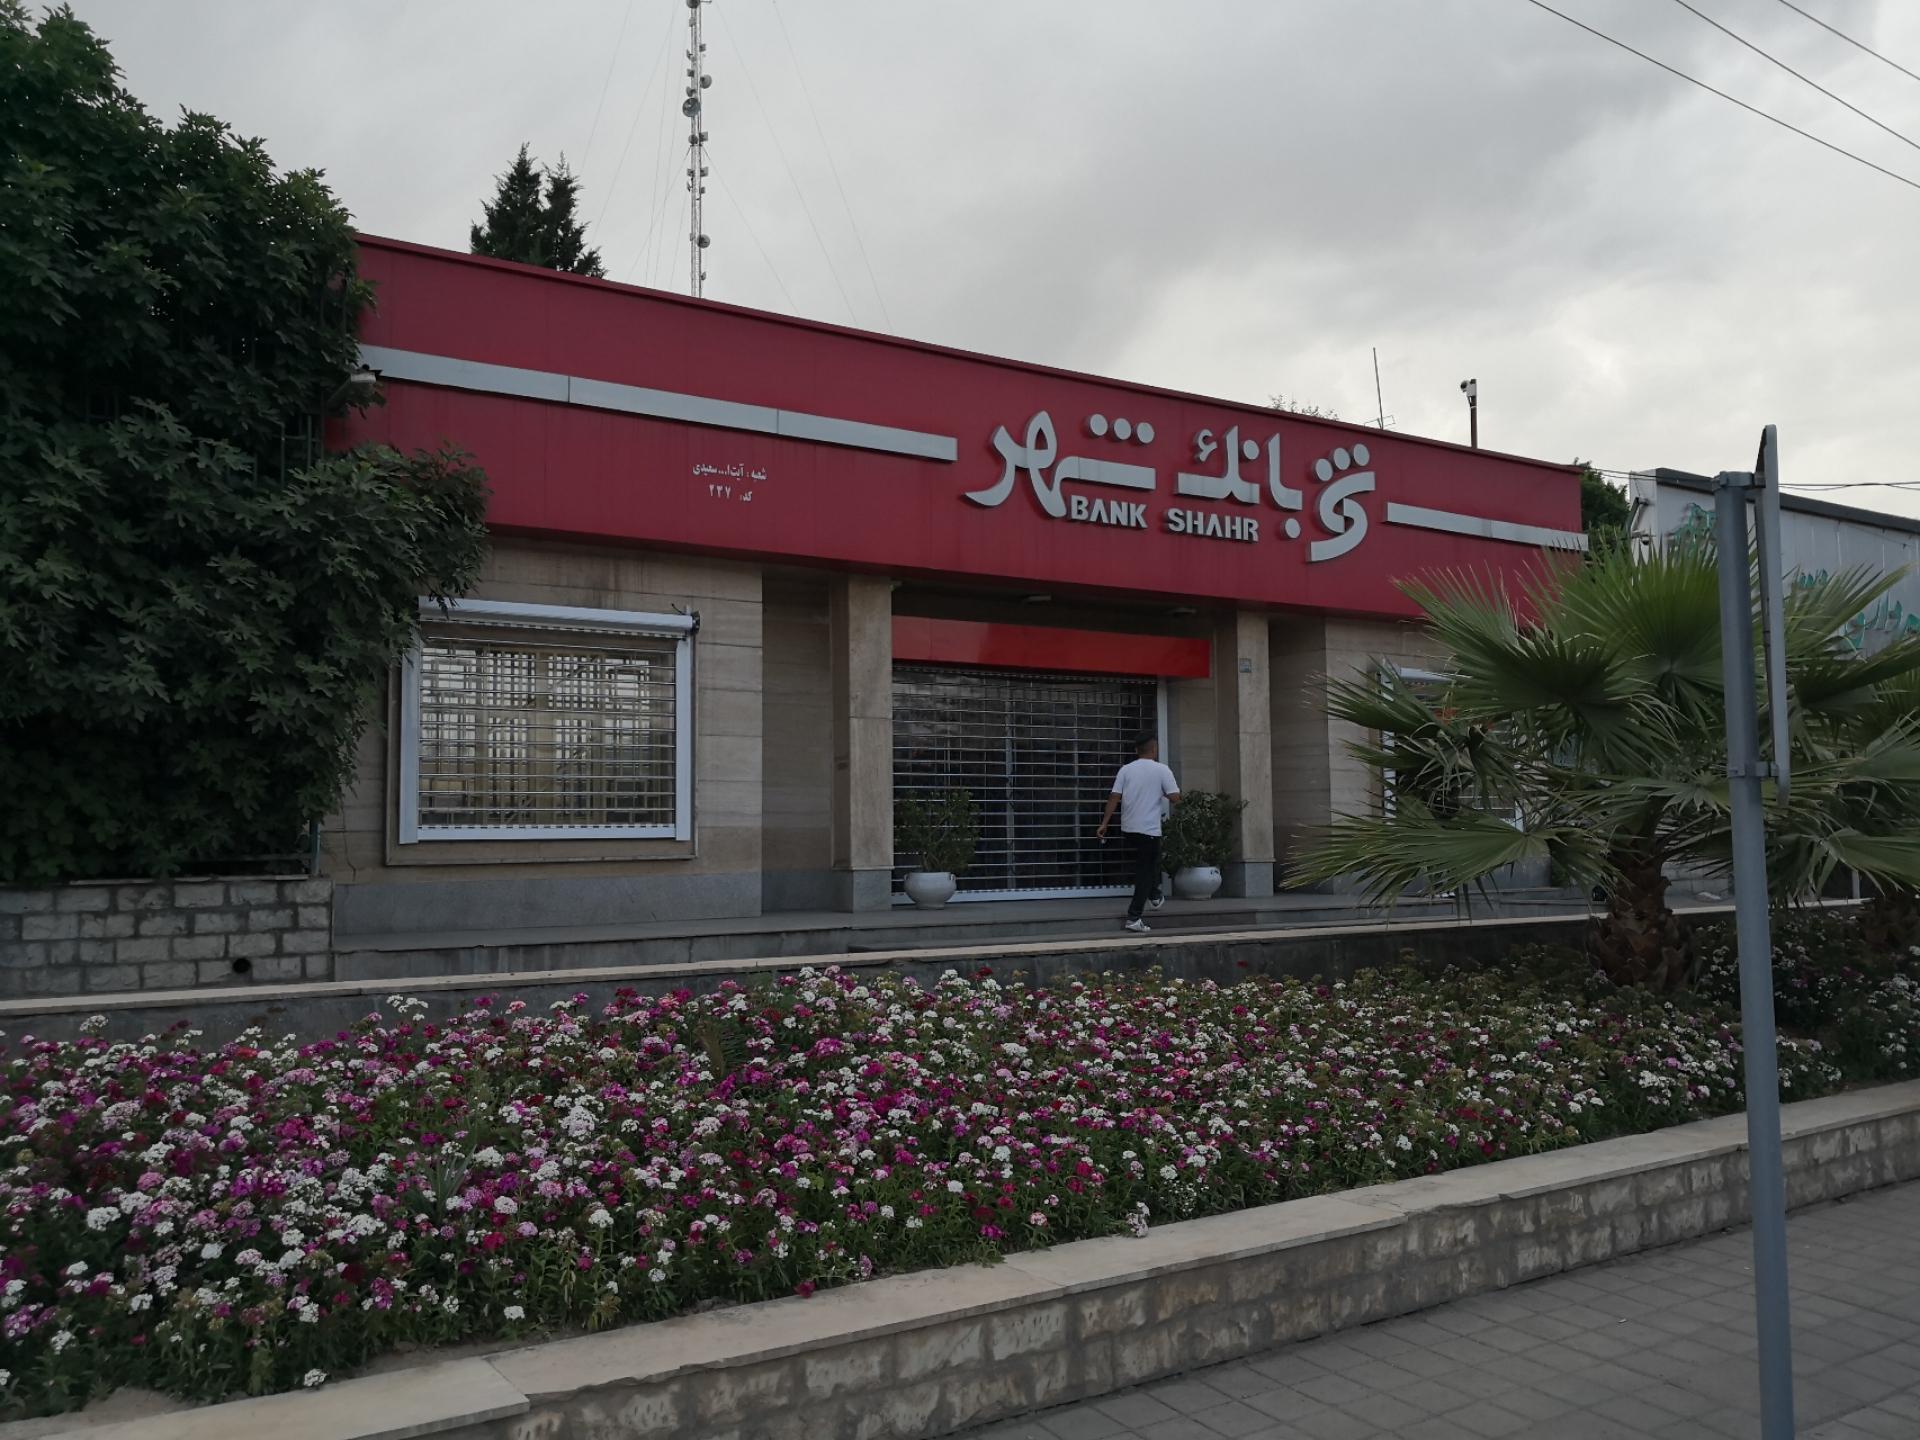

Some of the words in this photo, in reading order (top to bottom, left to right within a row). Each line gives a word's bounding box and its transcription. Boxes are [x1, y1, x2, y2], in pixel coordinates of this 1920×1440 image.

[964, 410, 1156, 518] شهر
[1069, 494, 1148, 529] BANK
[1166, 508, 1260, 542] SHAHR
